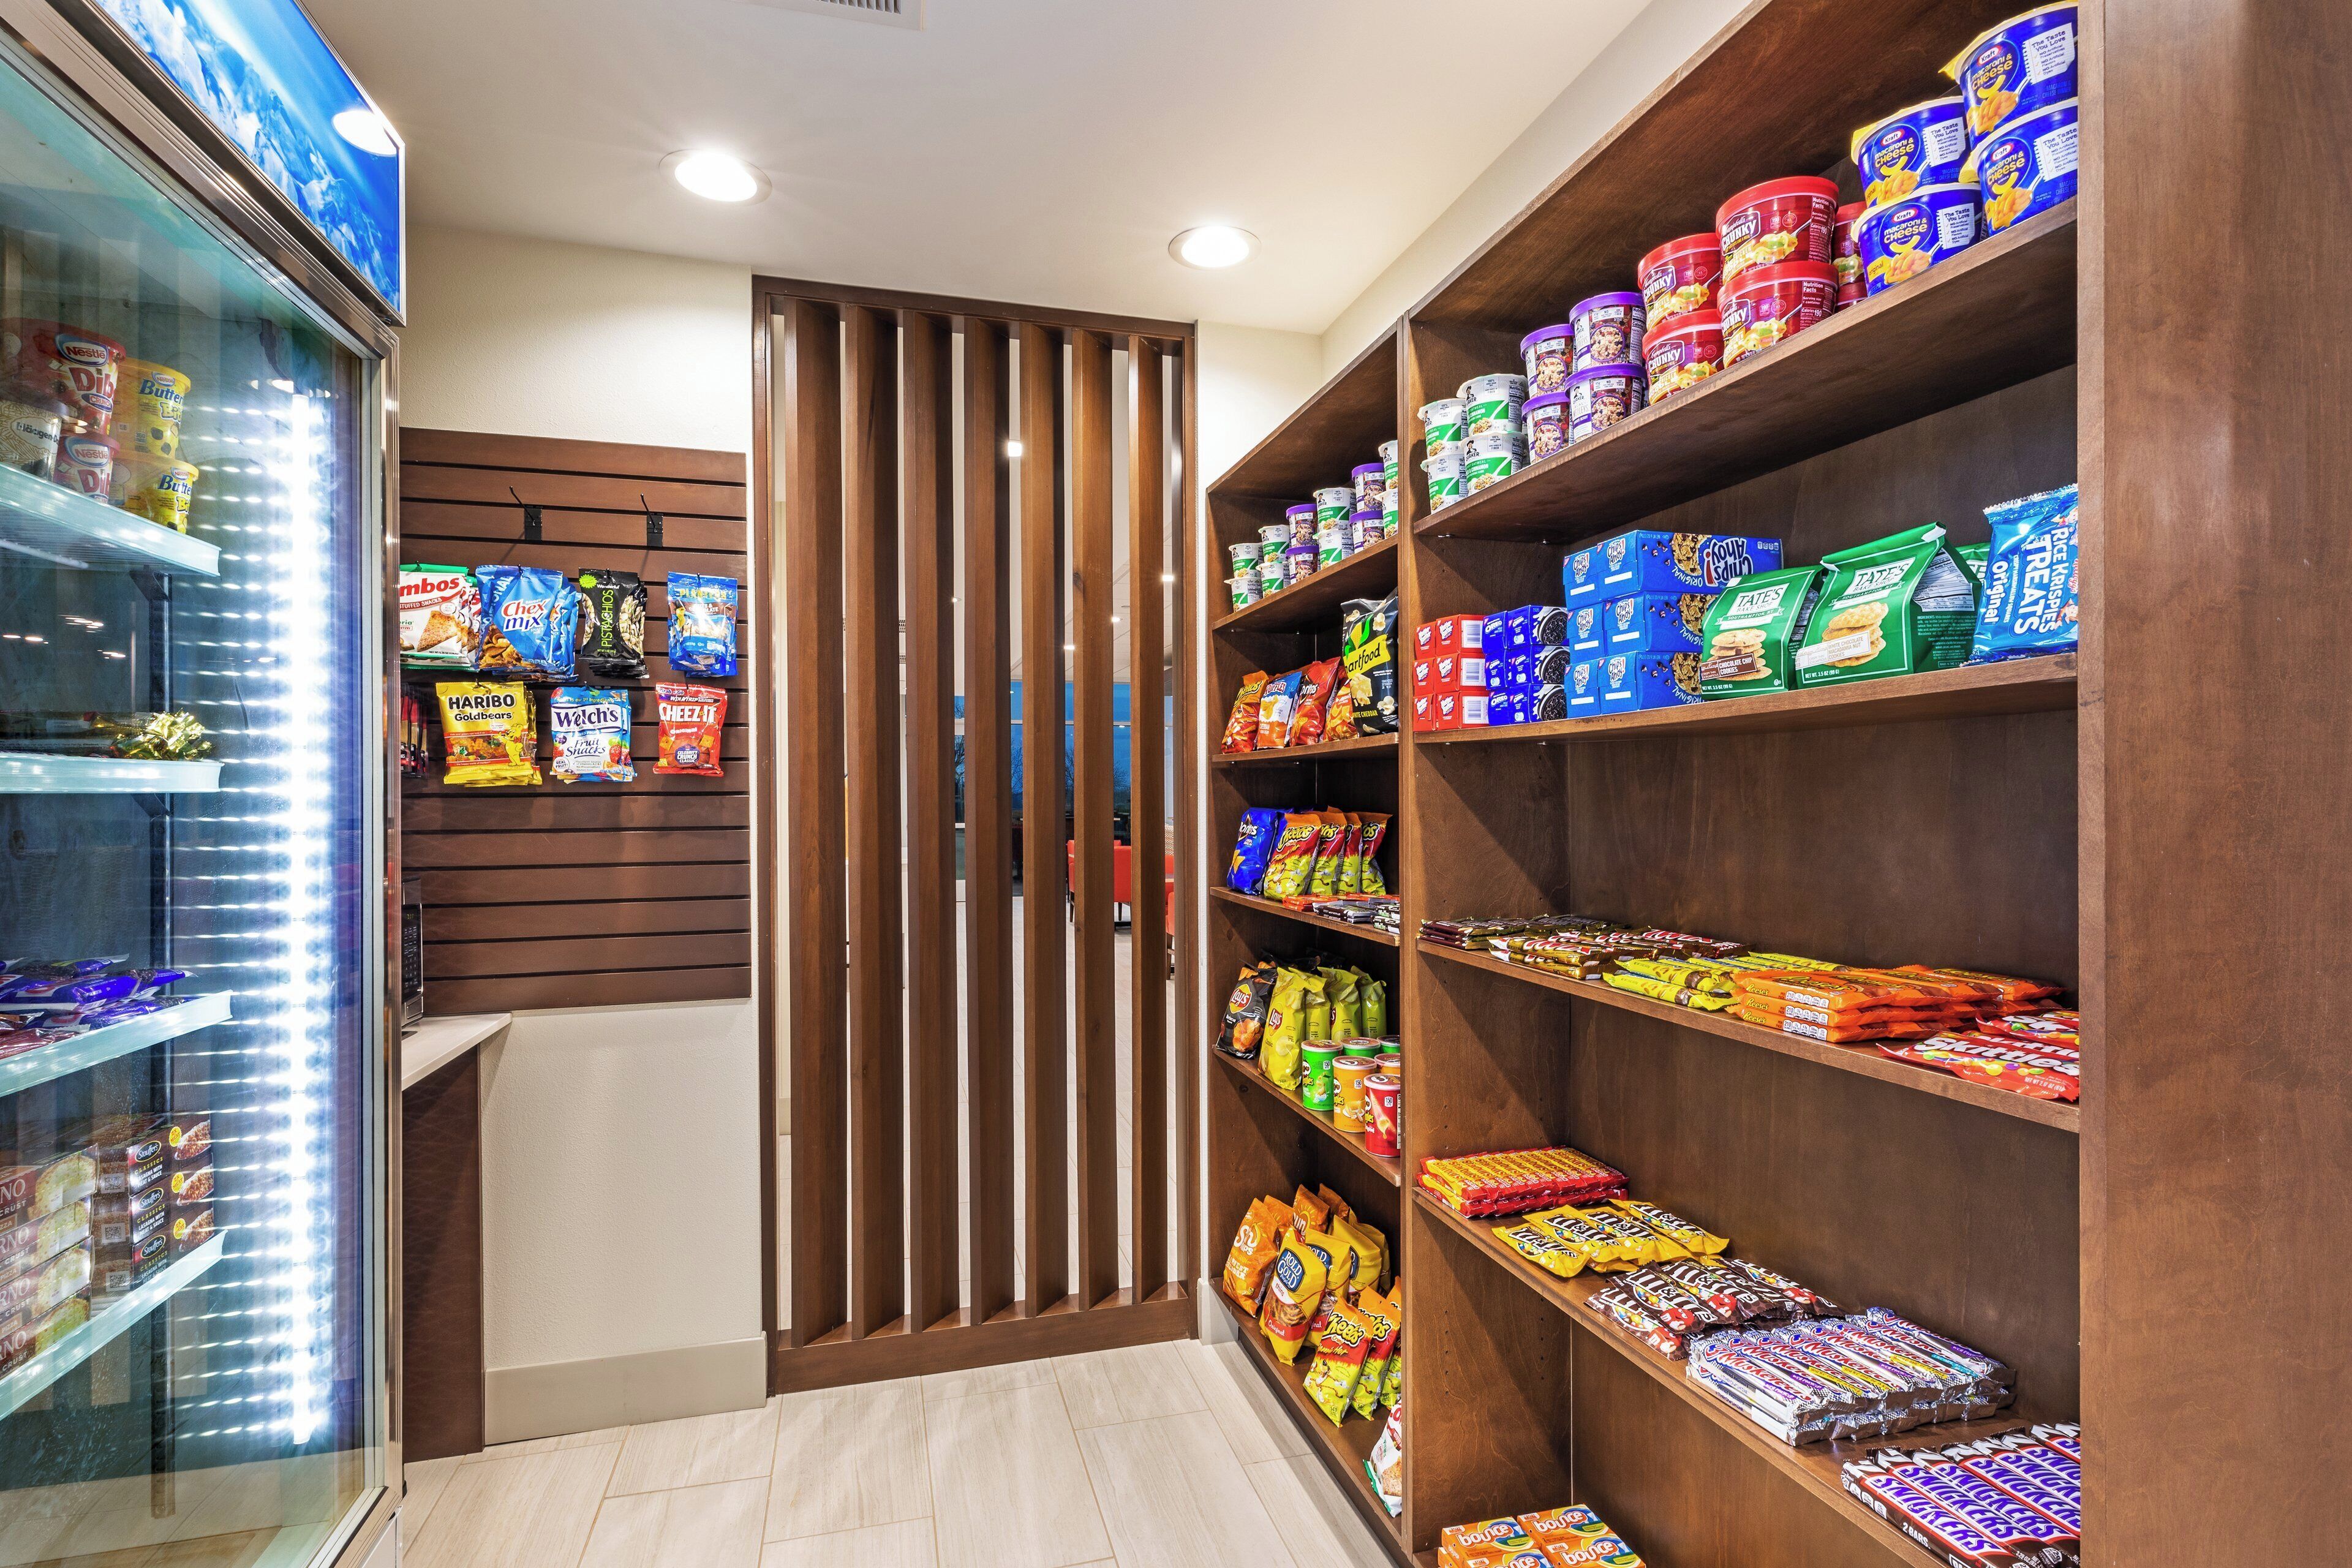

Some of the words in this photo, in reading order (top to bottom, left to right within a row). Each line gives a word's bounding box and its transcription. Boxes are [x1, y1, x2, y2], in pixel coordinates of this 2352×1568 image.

[2032, 40, 2045, 49] The
[2045, 30, 2066, 42] Taste
[2049, 37, 2066, 47] Love
[1981, 50, 1996, 62] Kraft
[1972, 56, 2005, 80] macaroni
[1885, 134, 1898, 143] Kraft
[2057, 127, 2078, 139] Taste
[2061, 134, 2078, 143] Love
[1875, 140, 1907, 159] macaroni
[1994, 147, 2008, 158] Kraft
[1987, 154, 2017, 177] macaroni
[1896, 211, 1912, 221] Kraft
[1722, 220, 1757, 246] CHUNKY
[1884, 219, 1920, 235] macaroni
[1644, 275, 1672, 300] CHUNKY
[1648, 349, 1681, 373] CHUNKY
[1607, 542, 1621, 557] Chips
[2052, 528, 2070, 563] RICE
[1574, 556, 1586, 570] Chips
[1671, 565, 1703, 587] ORIGINAL
[1855, 563, 1909, 588] TATE'S
[2008, 567, 2019, 603] MARSHMALLOW
[2014, 534, 2052, 635] TREATS
[1738, 587, 1784, 607] TATE'S
[2038, 562, 2069, 634] KRISPIES
[503, 599, 550, 616] Chex
[1616, 601, 1630, 616] Chips
[2003, 603, 2013, 623] SQUARES
[601, 590, 613, 647] PISTACHIOS
[1485, 620, 1502, 634] OREO
[1578, 612, 1589, 625] Chips
[1828, 645, 1852, 654] MACADAMIA
[1841, 636, 1863, 647] CHOCOLATE
[1609, 661, 1622, 673] Chips
[1719, 658, 1741, 669] CHOCOLATE
[1574, 667, 1586, 680] Chips
[448, 695, 514, 709] HARIBO
[1491, 695, 1507, 707] OREO
[454, 712, 512, 721] Goldbears
[554, 707, 619, 727] Welch's
[566, 745, 606, 756] Snacks
[575, 738, 600, 748] Fruit
[1231, 989, 1250, 1006] Lay's
[1746, 984, 1769, 995] Reese's
[1747, 998, 1769, 1010] Reese's
[1269, 1009, 1282, 1029] Lay's
[1743, 1011, 1766, 1024] Reese's
[1913, 1036, 2079, 1076] Skittles
[138, 1144, 159, 1159] Stouffer's
[134, 1156, 164, 1175] CLASSICS
[153, 1164, 163, 1174] WITH
[151, 1170, 162, 1180] SAUCE
[140, 1191, 160, 1207] Stouffer's
[137, 1204, 165, 1224] CLASSICS
[138, 1217, 154, 1231] LASAGNA
[155, 1212, 165, 1221] WITH
[154, 1218, 164, 1229] SAUCE
[144, 1238, 163, 1255] Stouffer's
[1286, 1251, 1302, 1276] ROLD
[1, 1269, 17, 1280] PIZZA
[1277, 1260, 1298, 1289] GOLD
[1275, 1282, 1284, 1297] thins
[1626, 1269, 1718, 1323] m&m's
[6, 1299, 30, 1317] CRUST
[2, 1320, 17, 1333] PIZZA
[1268, 1319, 1285, 1336] Original
[1333, 1346, 1348, 1355] Hot
[1705, 1344, 1729, 1357] 3
[2, 1351, 28, 1372] CRUST
[1902, 1467, 2022, 1539] SNICKERS
[1938, 1463, 2063, 1538] SNICKERS
[1535, 1510, 1583, 1533] bounce
[1869, 1476, 2005, 1553] SNICKERS
[1458, 1523, 1513, 1547] bounce
[1902, 1522, 1909, 1534] 2
[1909, 1526, 1931, 1550] BARS.
[1563, 1540, 1615, 1564] bounce
